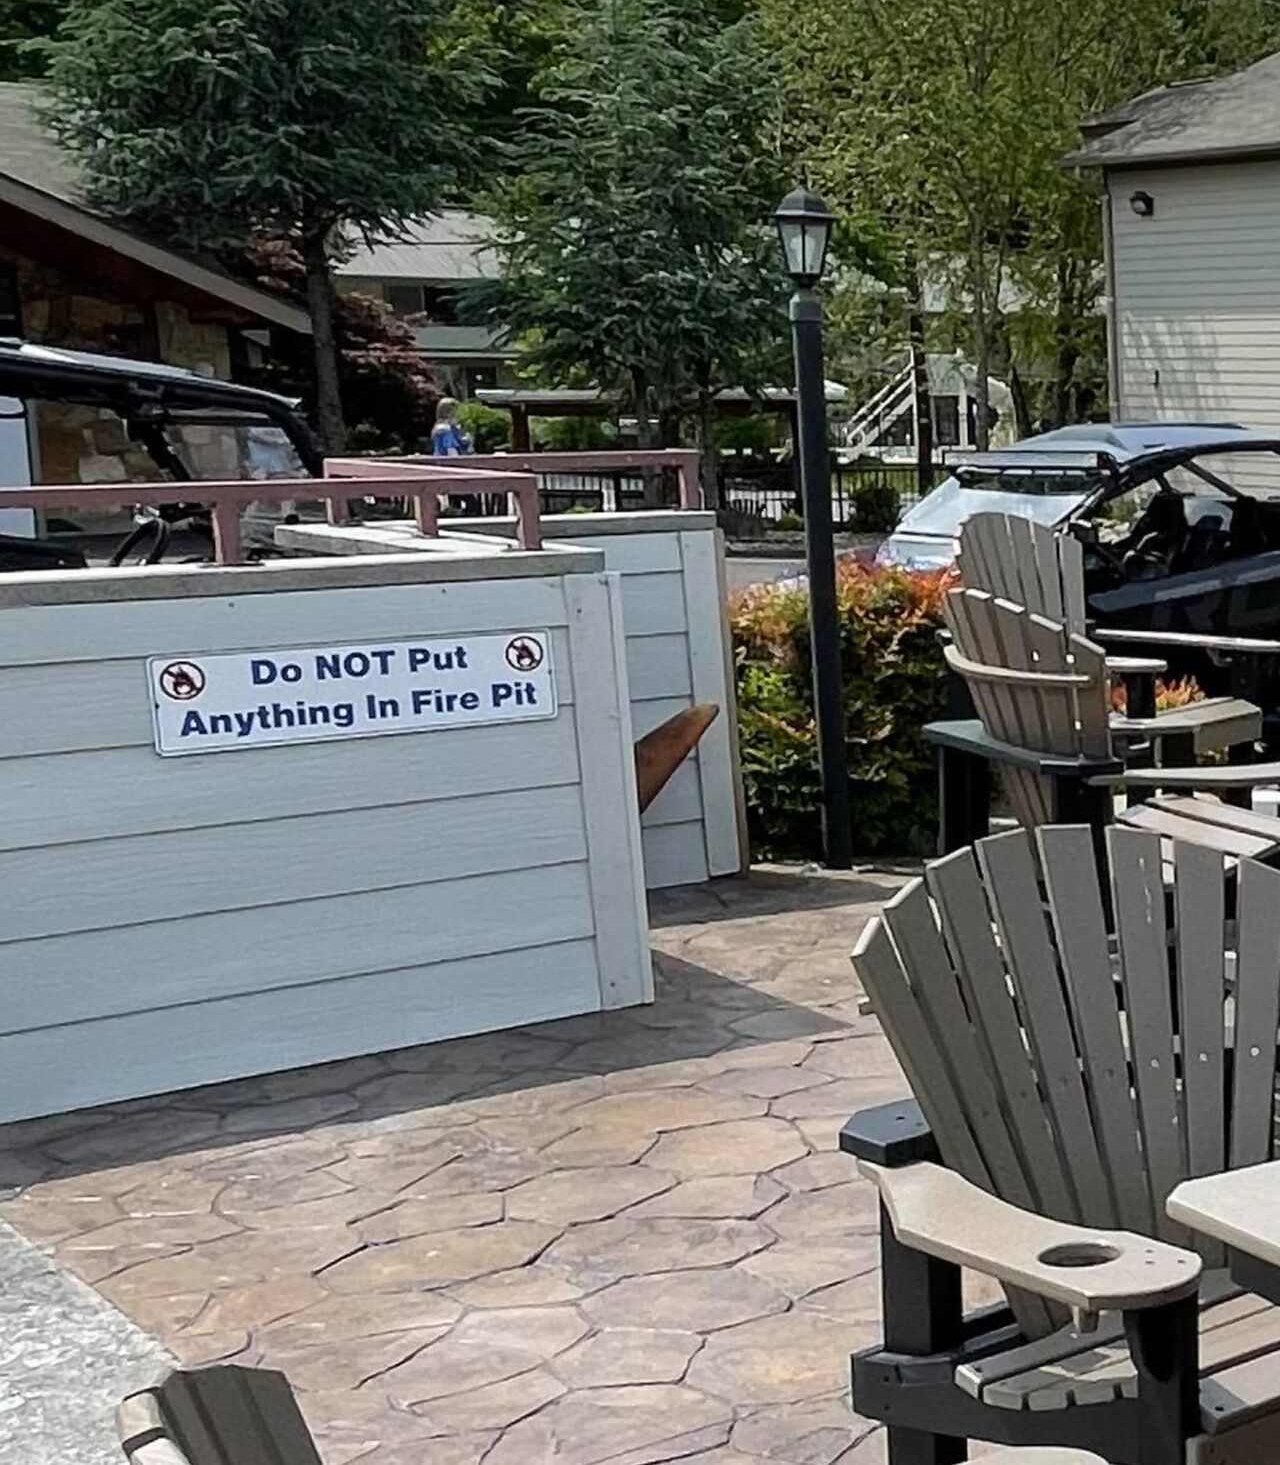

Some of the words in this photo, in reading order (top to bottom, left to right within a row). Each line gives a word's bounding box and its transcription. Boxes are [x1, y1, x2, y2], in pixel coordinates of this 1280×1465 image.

[250, 659, 302, 685] Do
[315, 649, 396, 680] NOT
[408, 646, 468, 673] Put
[180, 700, 354, 738] Anything
[365, 694, 400, 720] In
[411, 689, 480, 715] Fire
[491, 681, 537, 708] Pit
